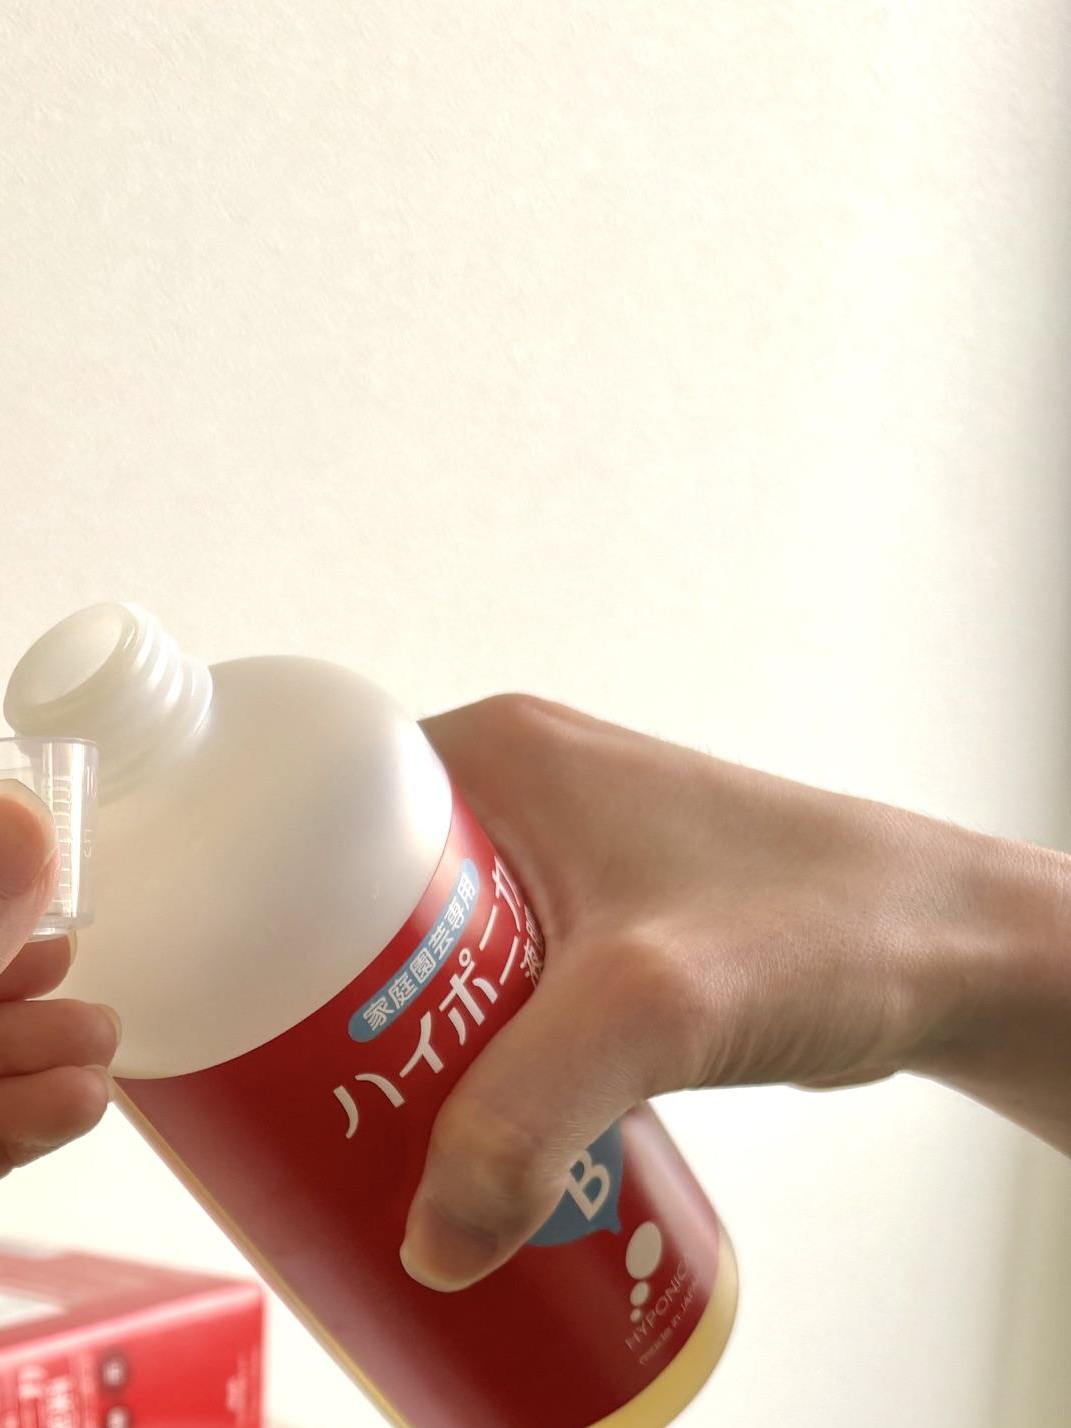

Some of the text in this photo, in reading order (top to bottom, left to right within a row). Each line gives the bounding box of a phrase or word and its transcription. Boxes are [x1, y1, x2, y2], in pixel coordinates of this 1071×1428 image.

[332, 854, 521, 1140] ハイポニカ
[362, 871, 476, 1032] 家庭園芸専用
[563, 1150, 612, 1222] B
